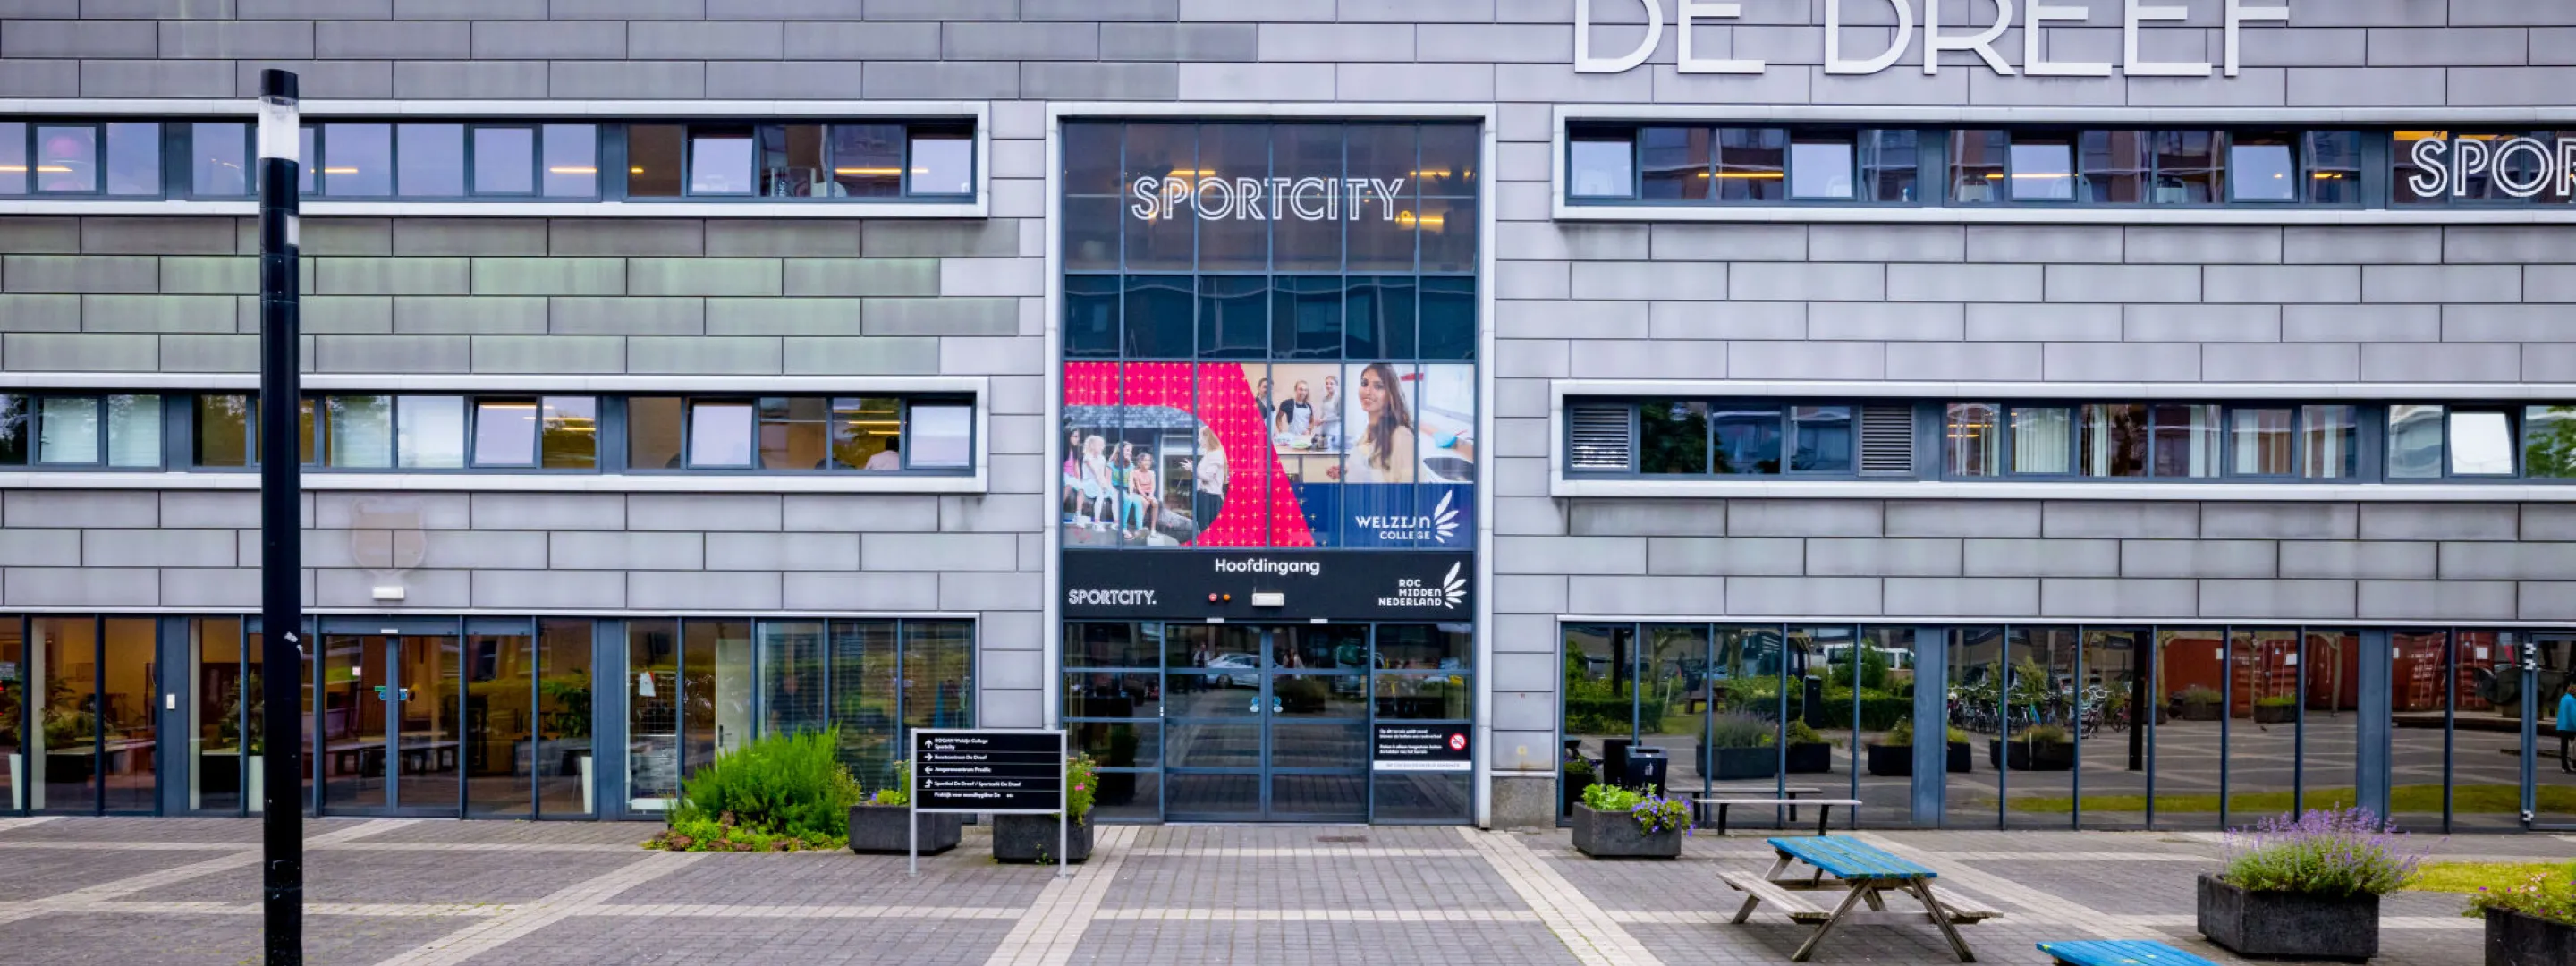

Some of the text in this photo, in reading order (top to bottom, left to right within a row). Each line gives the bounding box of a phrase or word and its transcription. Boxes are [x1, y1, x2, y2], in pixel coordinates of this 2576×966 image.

[1574, 0, 2290, 78] DE DREEF
[1131, 176, 1405, 221] SPORTCITY
[1355, 515, 1431, 529] WELZIJN
[1379, 530, 1431, 540] COLLEGE
[1214, 558, 1321, 575] Hoofdingang
[1398, 579, 1422, 588] ROC
[1398, 589, 1442, 597] MIDDEN
[1378, 597, 1442, 606] NEDERLAND
